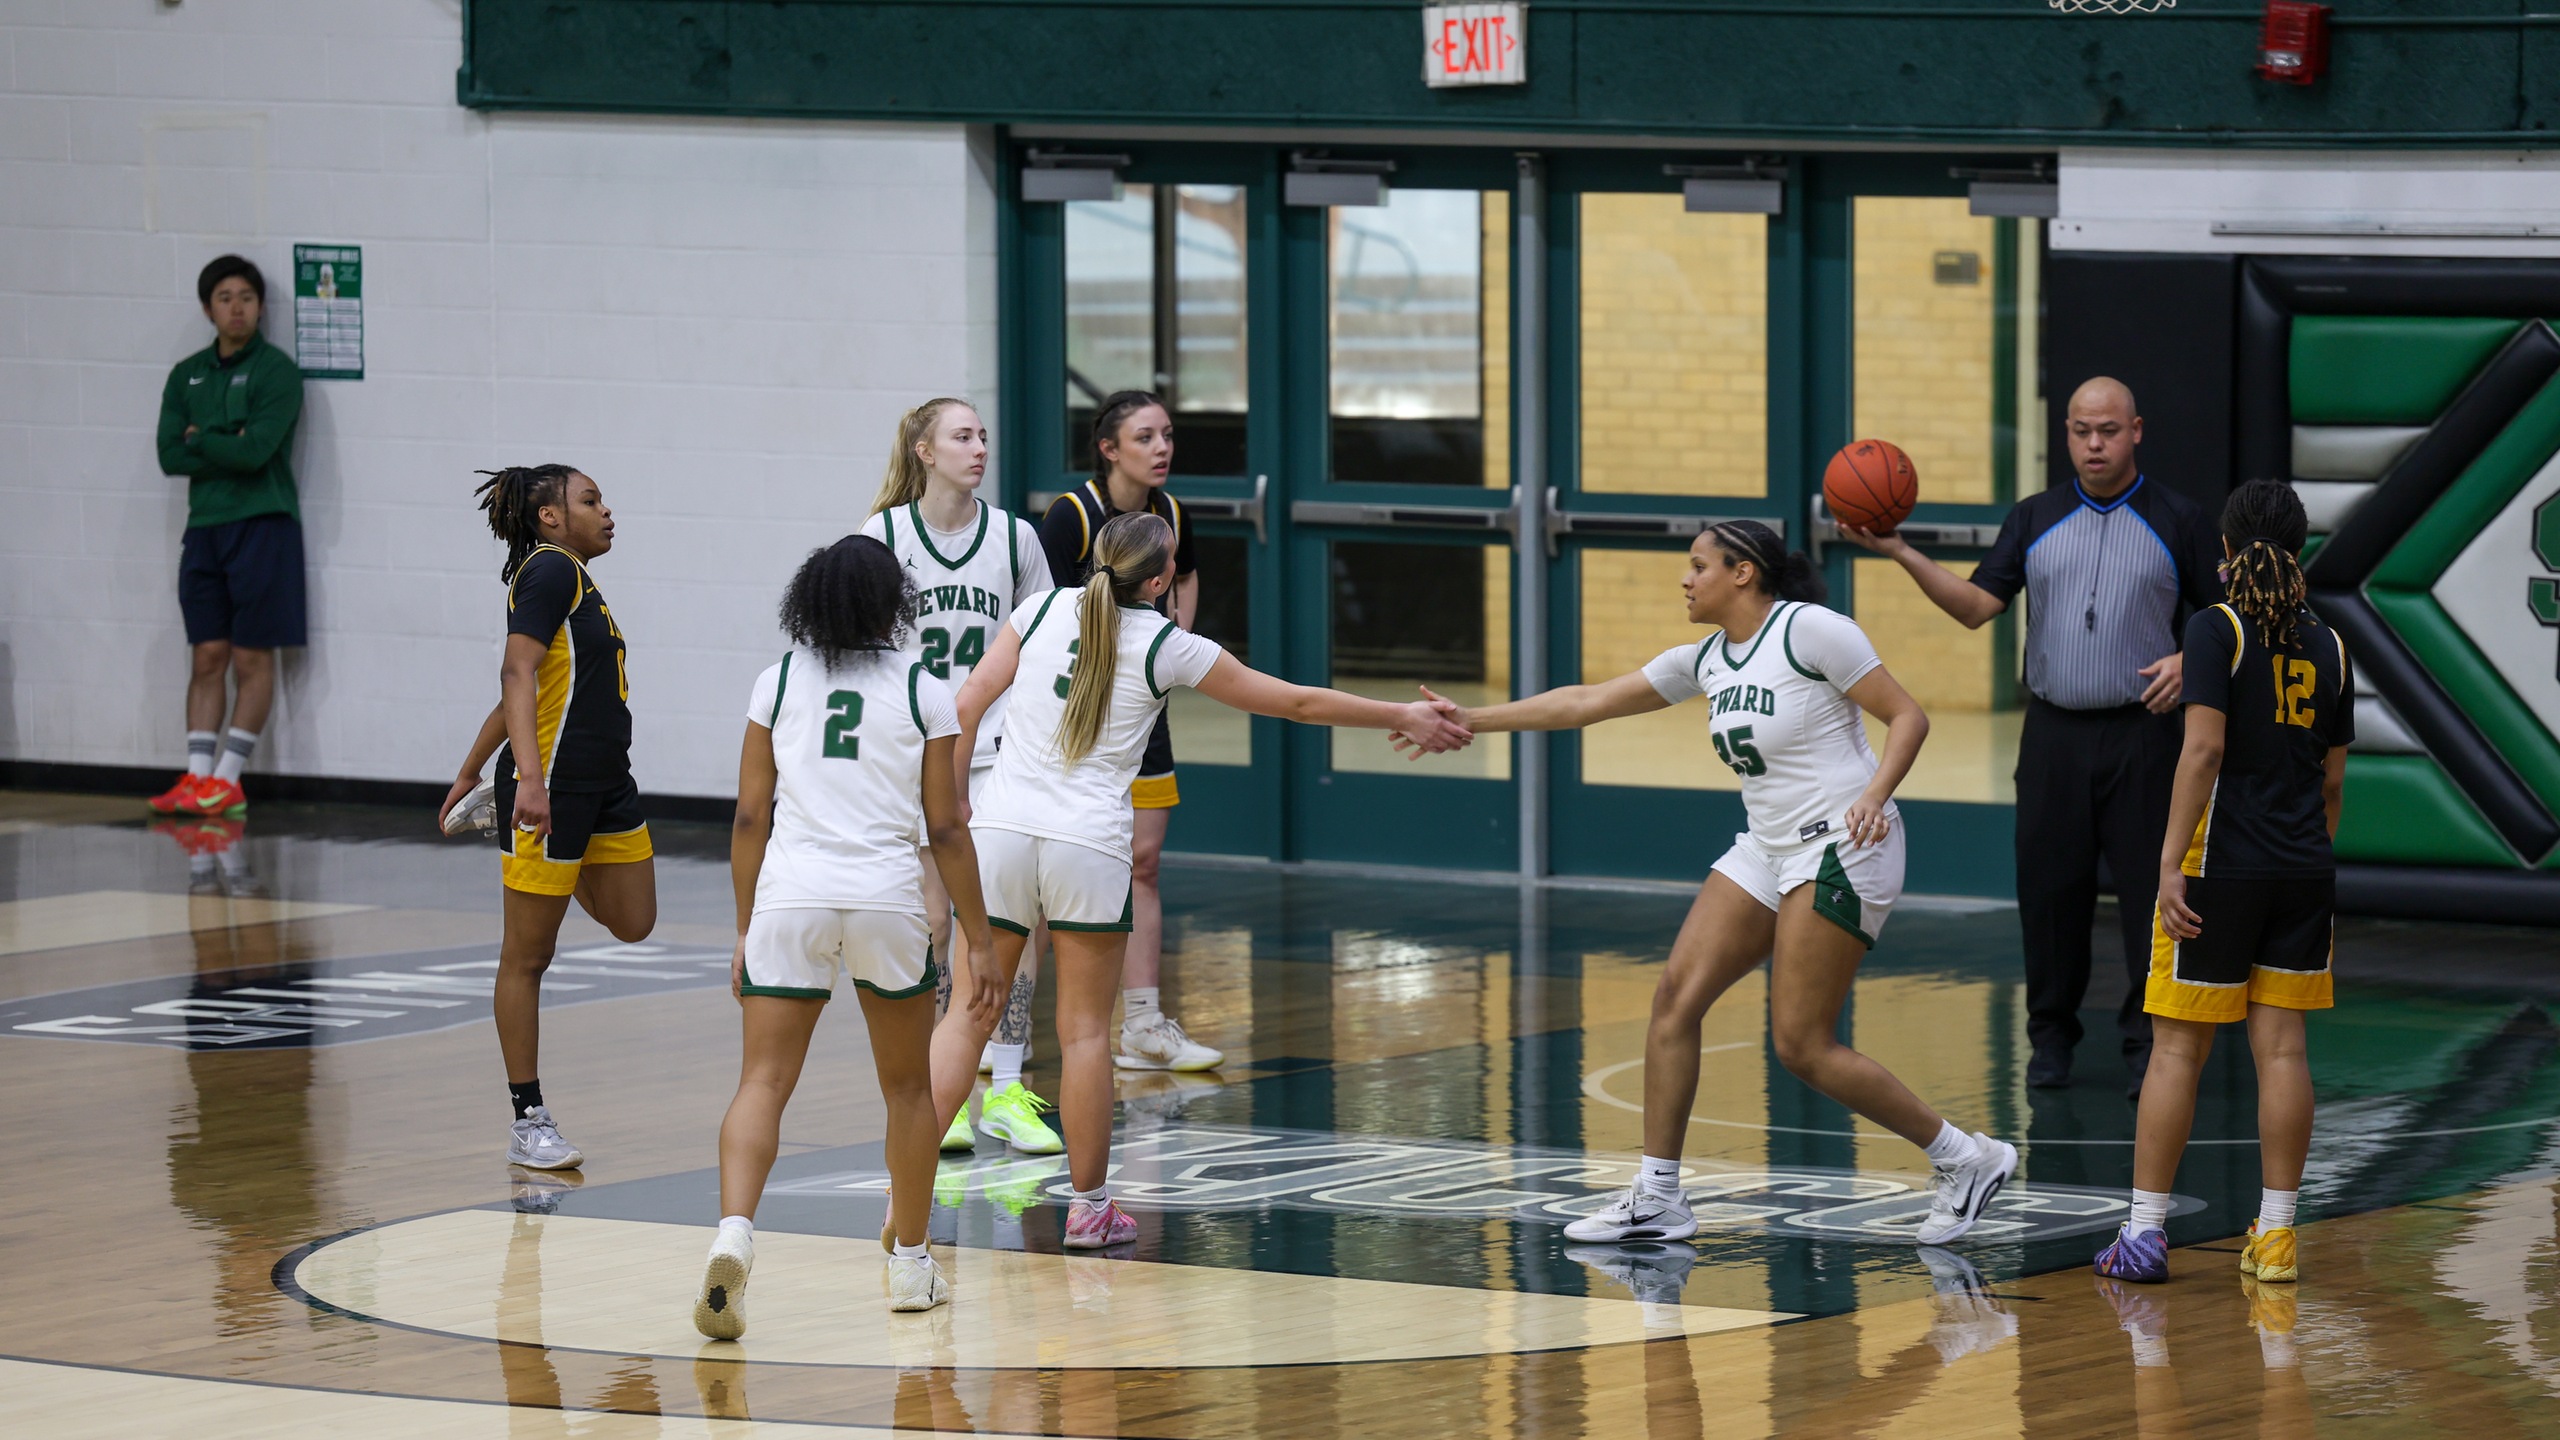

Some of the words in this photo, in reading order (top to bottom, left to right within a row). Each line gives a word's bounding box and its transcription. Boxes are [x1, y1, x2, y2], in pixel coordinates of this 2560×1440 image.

[1444, 16, 1506, 73] EXIT
[920, 626, 985, 680] 24
[1708, 684, 1774, 722] EWARD
[2272, 653, 2316, 729] 12
[822, 689, 865, 761] 2
